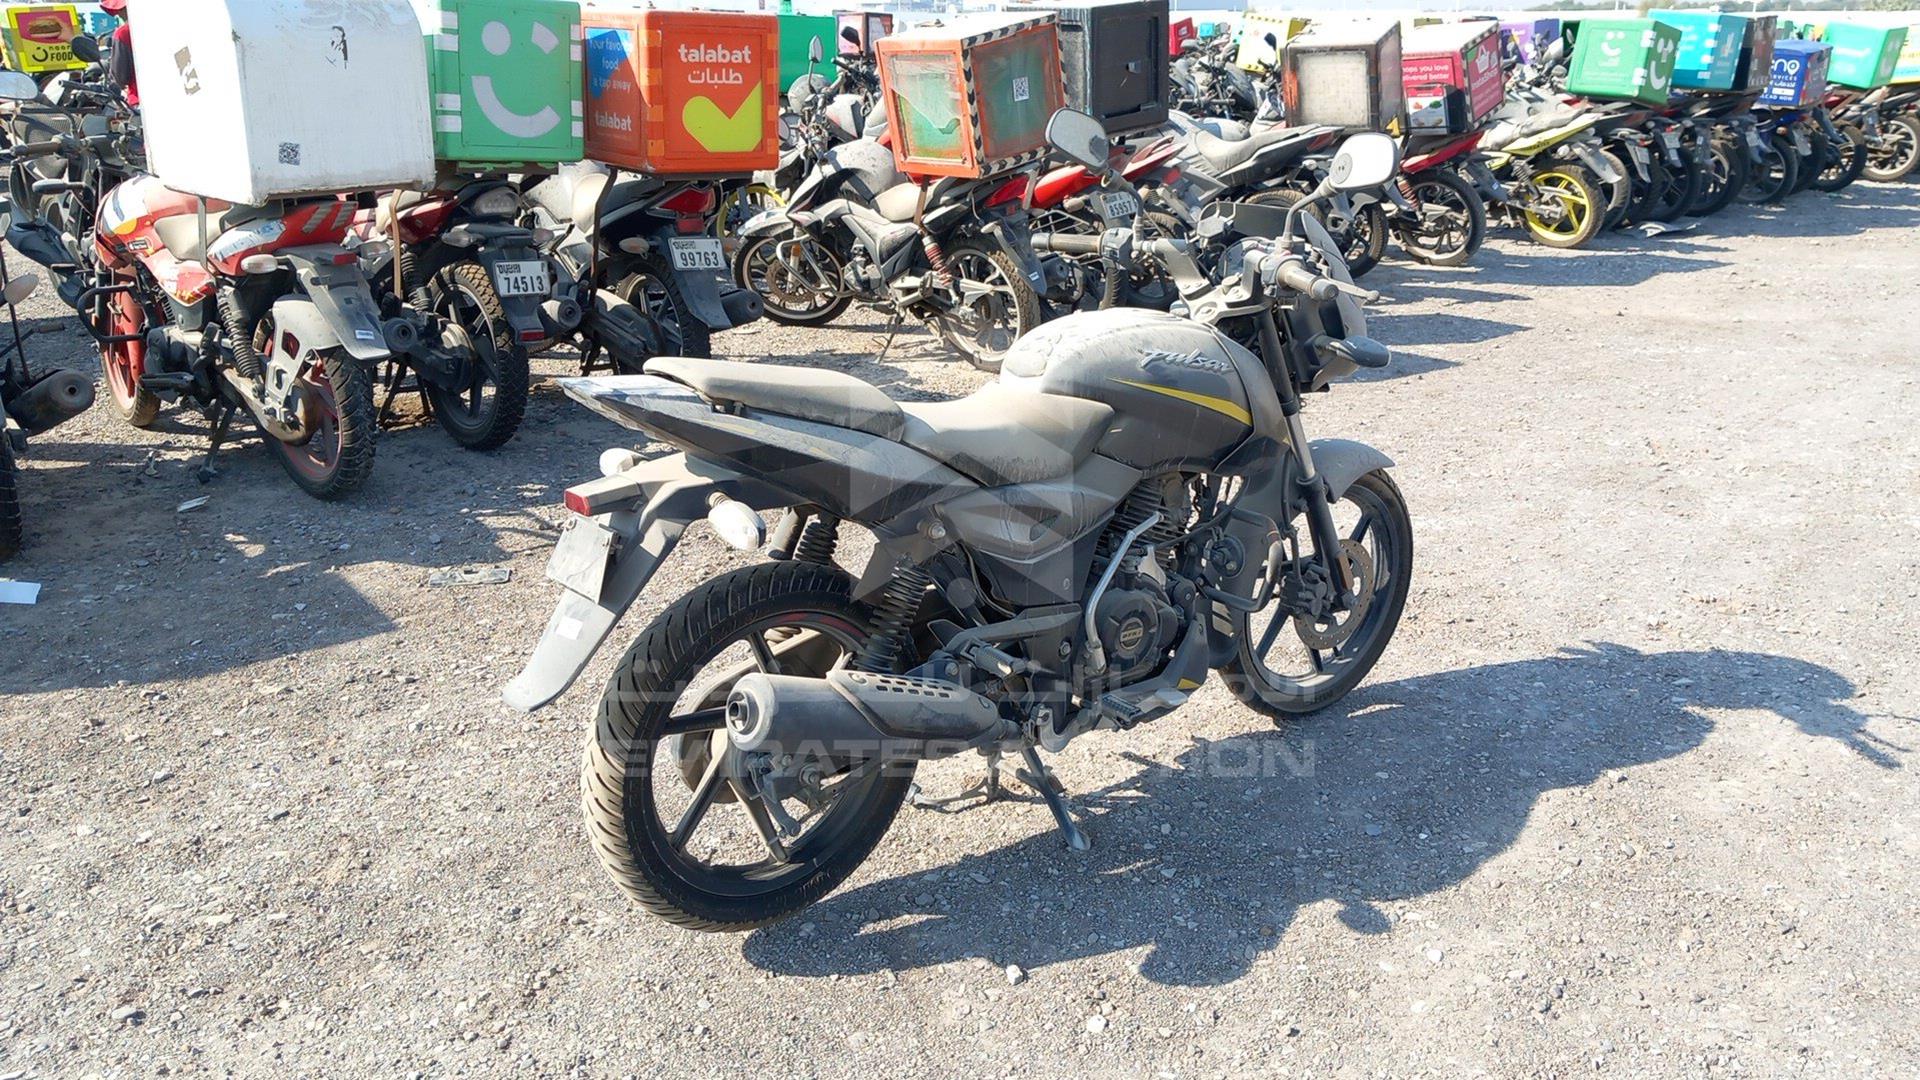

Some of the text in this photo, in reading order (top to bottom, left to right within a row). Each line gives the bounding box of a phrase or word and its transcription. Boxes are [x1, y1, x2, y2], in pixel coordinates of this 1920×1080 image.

[50, 52, 73, 61] FOOD
[678, 43, 752, 64] talabat
[687, 67, 743, 89] طلبات
[1419, 65, 1433, 73] you
[595, 111, 633, 131] talabat
[680, 251, 720, 267] 99763
[503, 275, 545, 293] 74513
